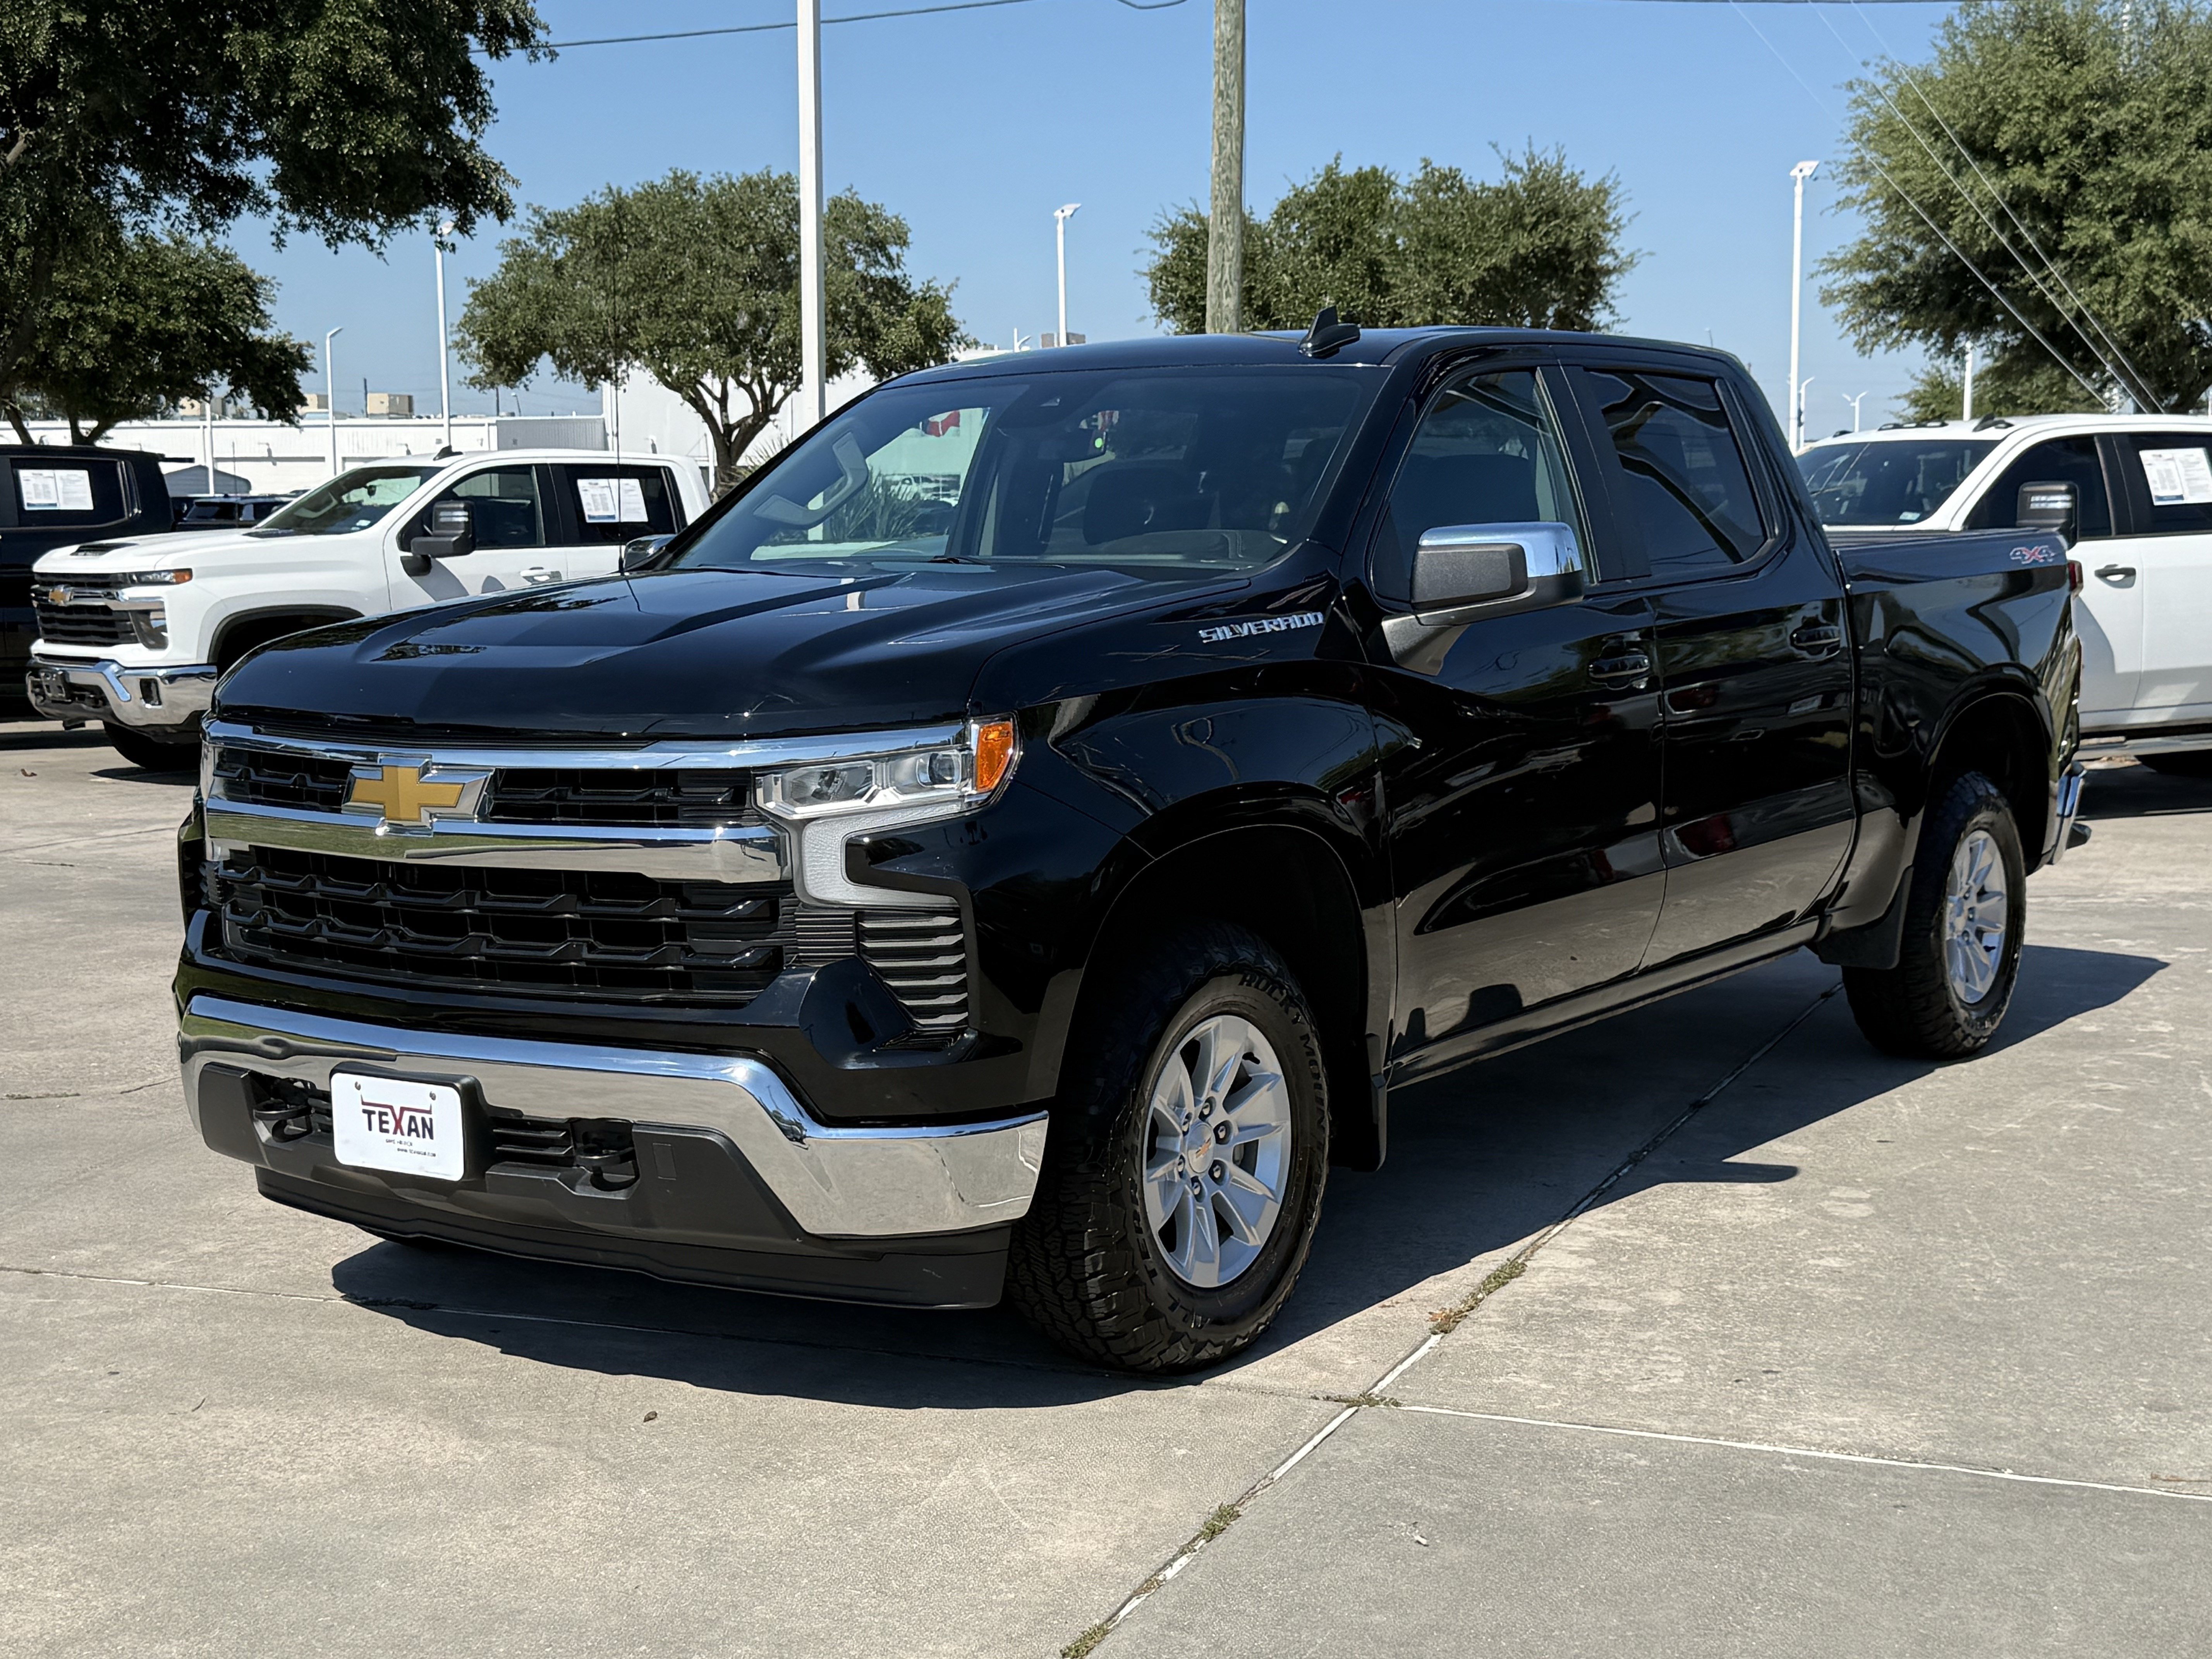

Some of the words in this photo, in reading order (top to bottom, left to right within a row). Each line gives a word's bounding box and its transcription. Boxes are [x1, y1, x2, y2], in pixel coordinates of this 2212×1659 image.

[1199, 611, 1324, 643] SILVERADO
[1238, 973, 1307, 1025] ROCKY
[361, 1102, 434, 1140] TEXAN
